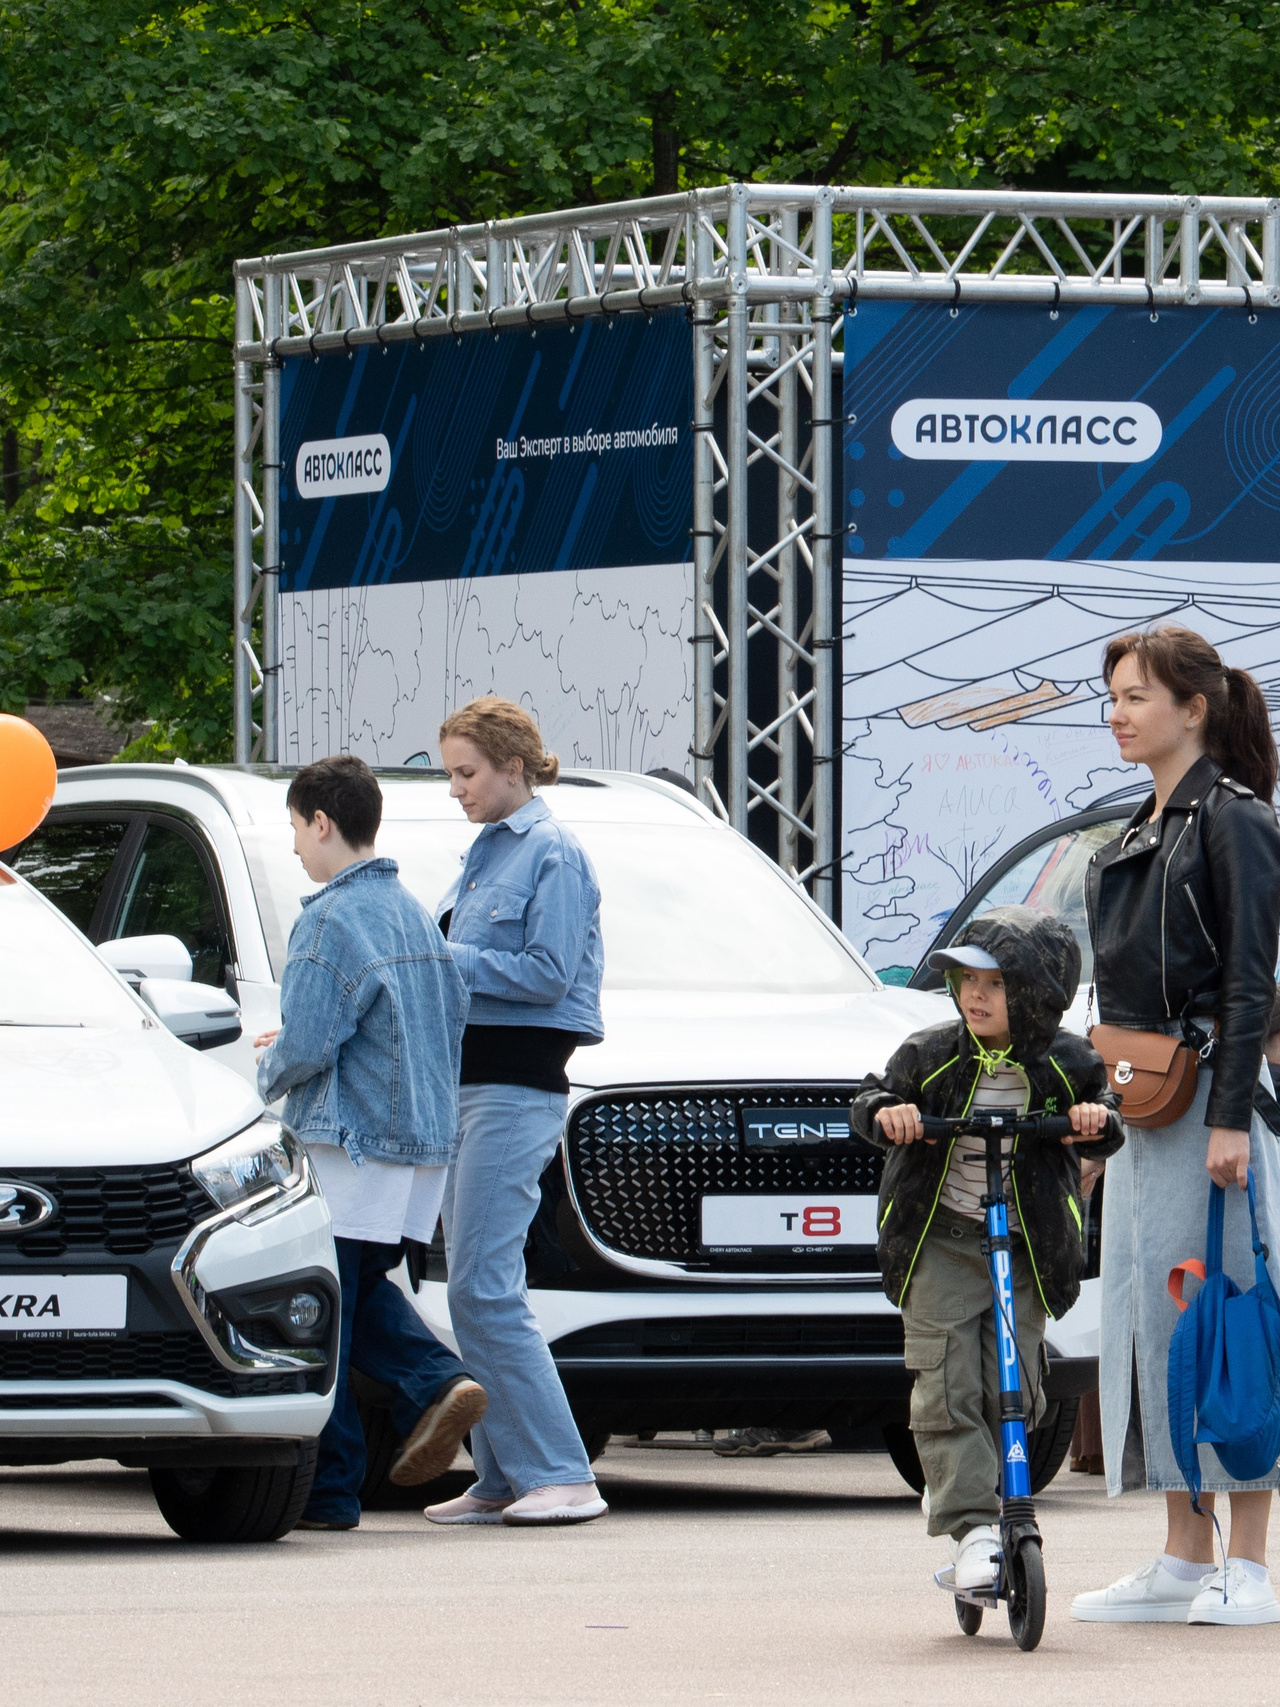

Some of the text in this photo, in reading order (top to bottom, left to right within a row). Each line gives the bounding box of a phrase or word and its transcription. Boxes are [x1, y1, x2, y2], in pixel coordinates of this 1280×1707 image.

[496, 421, 678, 460] Ваш Эксперт в выборе автомобиля
[915, 413, 1138, 446] АВТОКЛАСС
[304, 447, 383, 484] АВТОКЛАСС
[779, 1205, 842, 1237] T8
